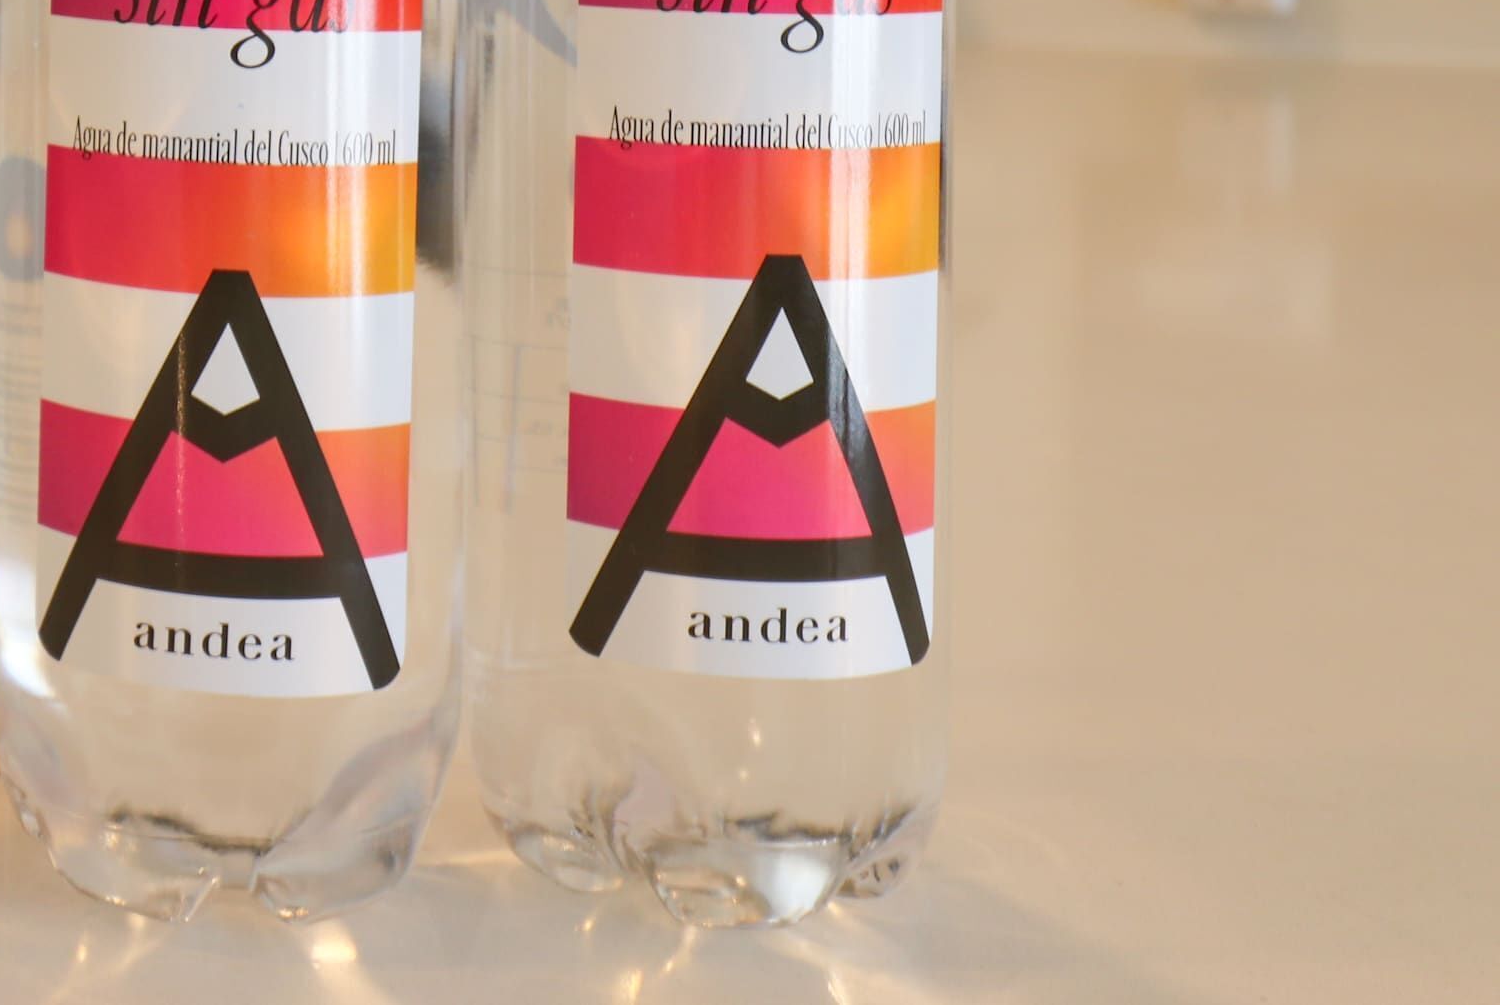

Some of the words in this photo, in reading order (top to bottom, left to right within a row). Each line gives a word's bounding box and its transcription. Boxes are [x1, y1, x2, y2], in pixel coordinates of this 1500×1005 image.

[73, 115, 111, 160] Agua
[116, 121, 137, 158] de
[142, 129, 238, 166] manantial
[244, 130, 273, 166] del
[278, 131, 329, 167] Cusco
[342, 131, 374, 166] 600
[378, 130, 397, 165] ml
[609, 105, 655, 150] Agua
[661, 109, 684, 145] de
[690, 114, 790, 150] manantial
[796, 114, 822, 150] del
[828, 114, 873, 150] Cusco
[884, 113, 909, 148] 600
[912, 109, 926, 146] ml
[133, 621, 295, 662] andea
[688, 607, 849, 644] andea
